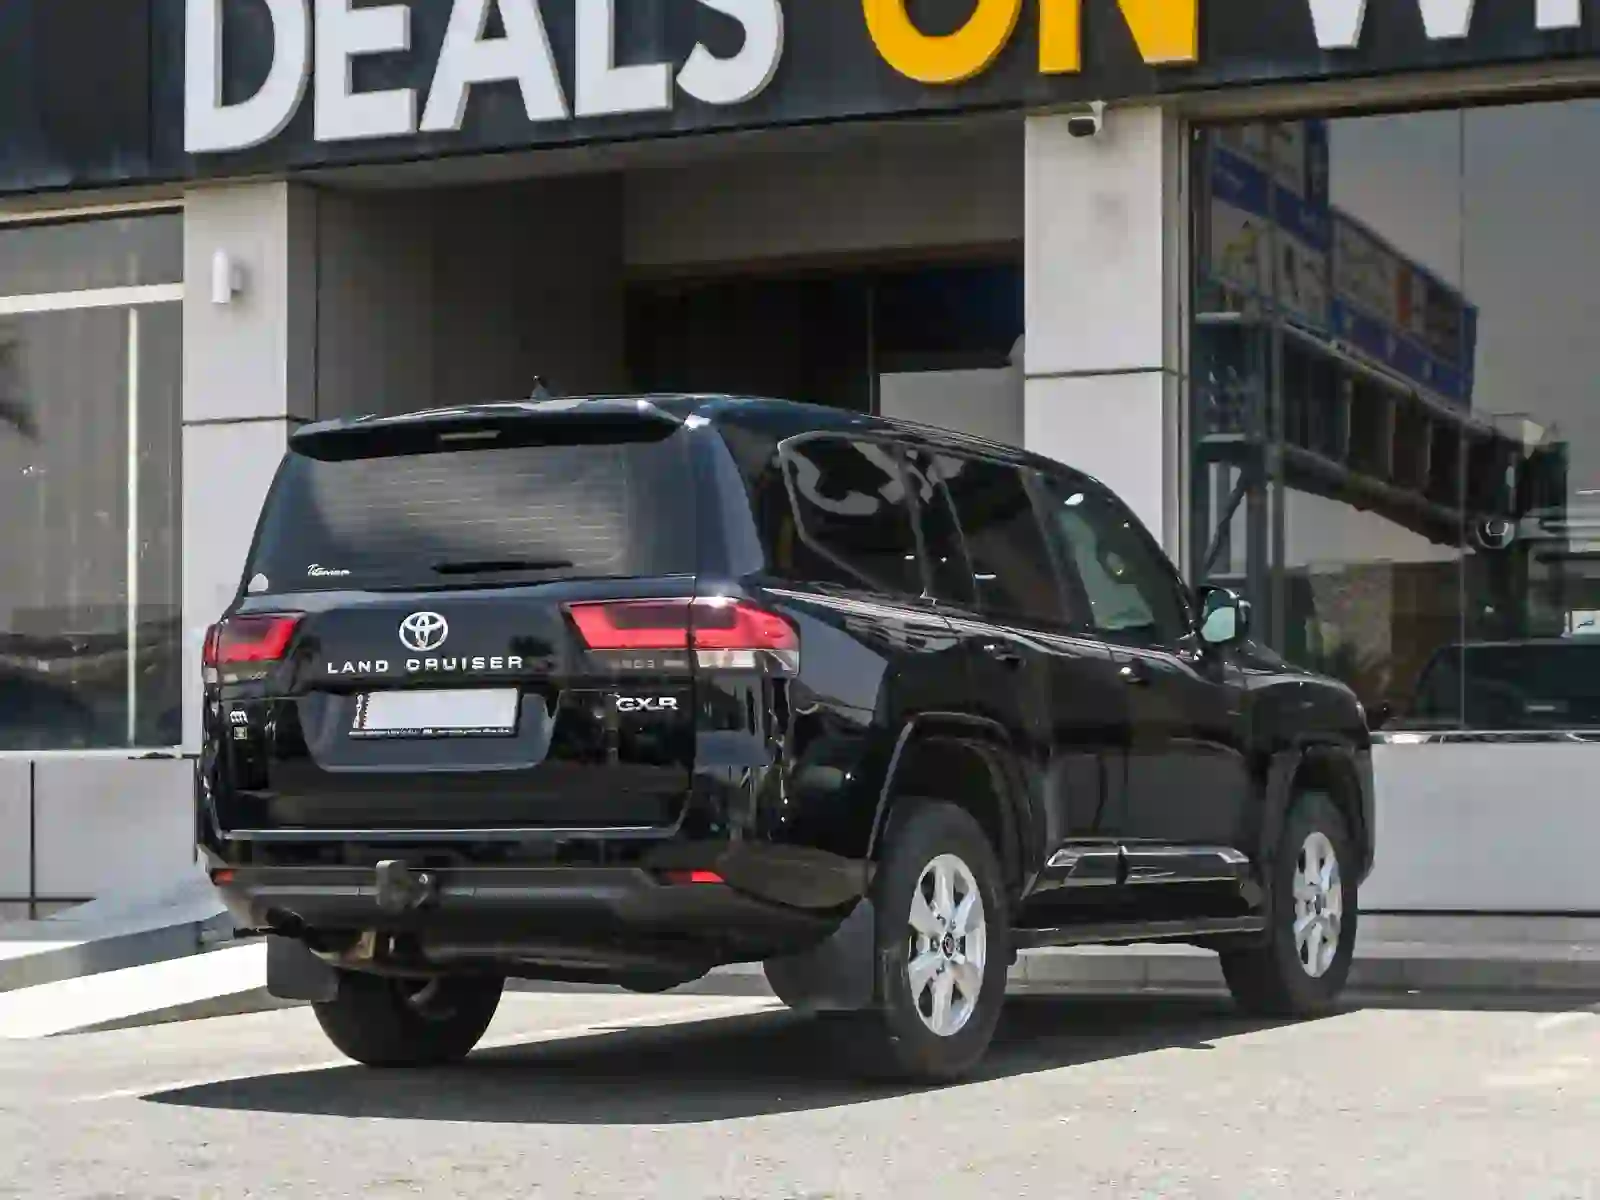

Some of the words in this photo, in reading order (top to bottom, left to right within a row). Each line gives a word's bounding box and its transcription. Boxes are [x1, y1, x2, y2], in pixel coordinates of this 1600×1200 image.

[327, 659, 389, 674] LAND
[405, 655, 524, 672] CRUISER
[616, 696, 679, 712] GXR
